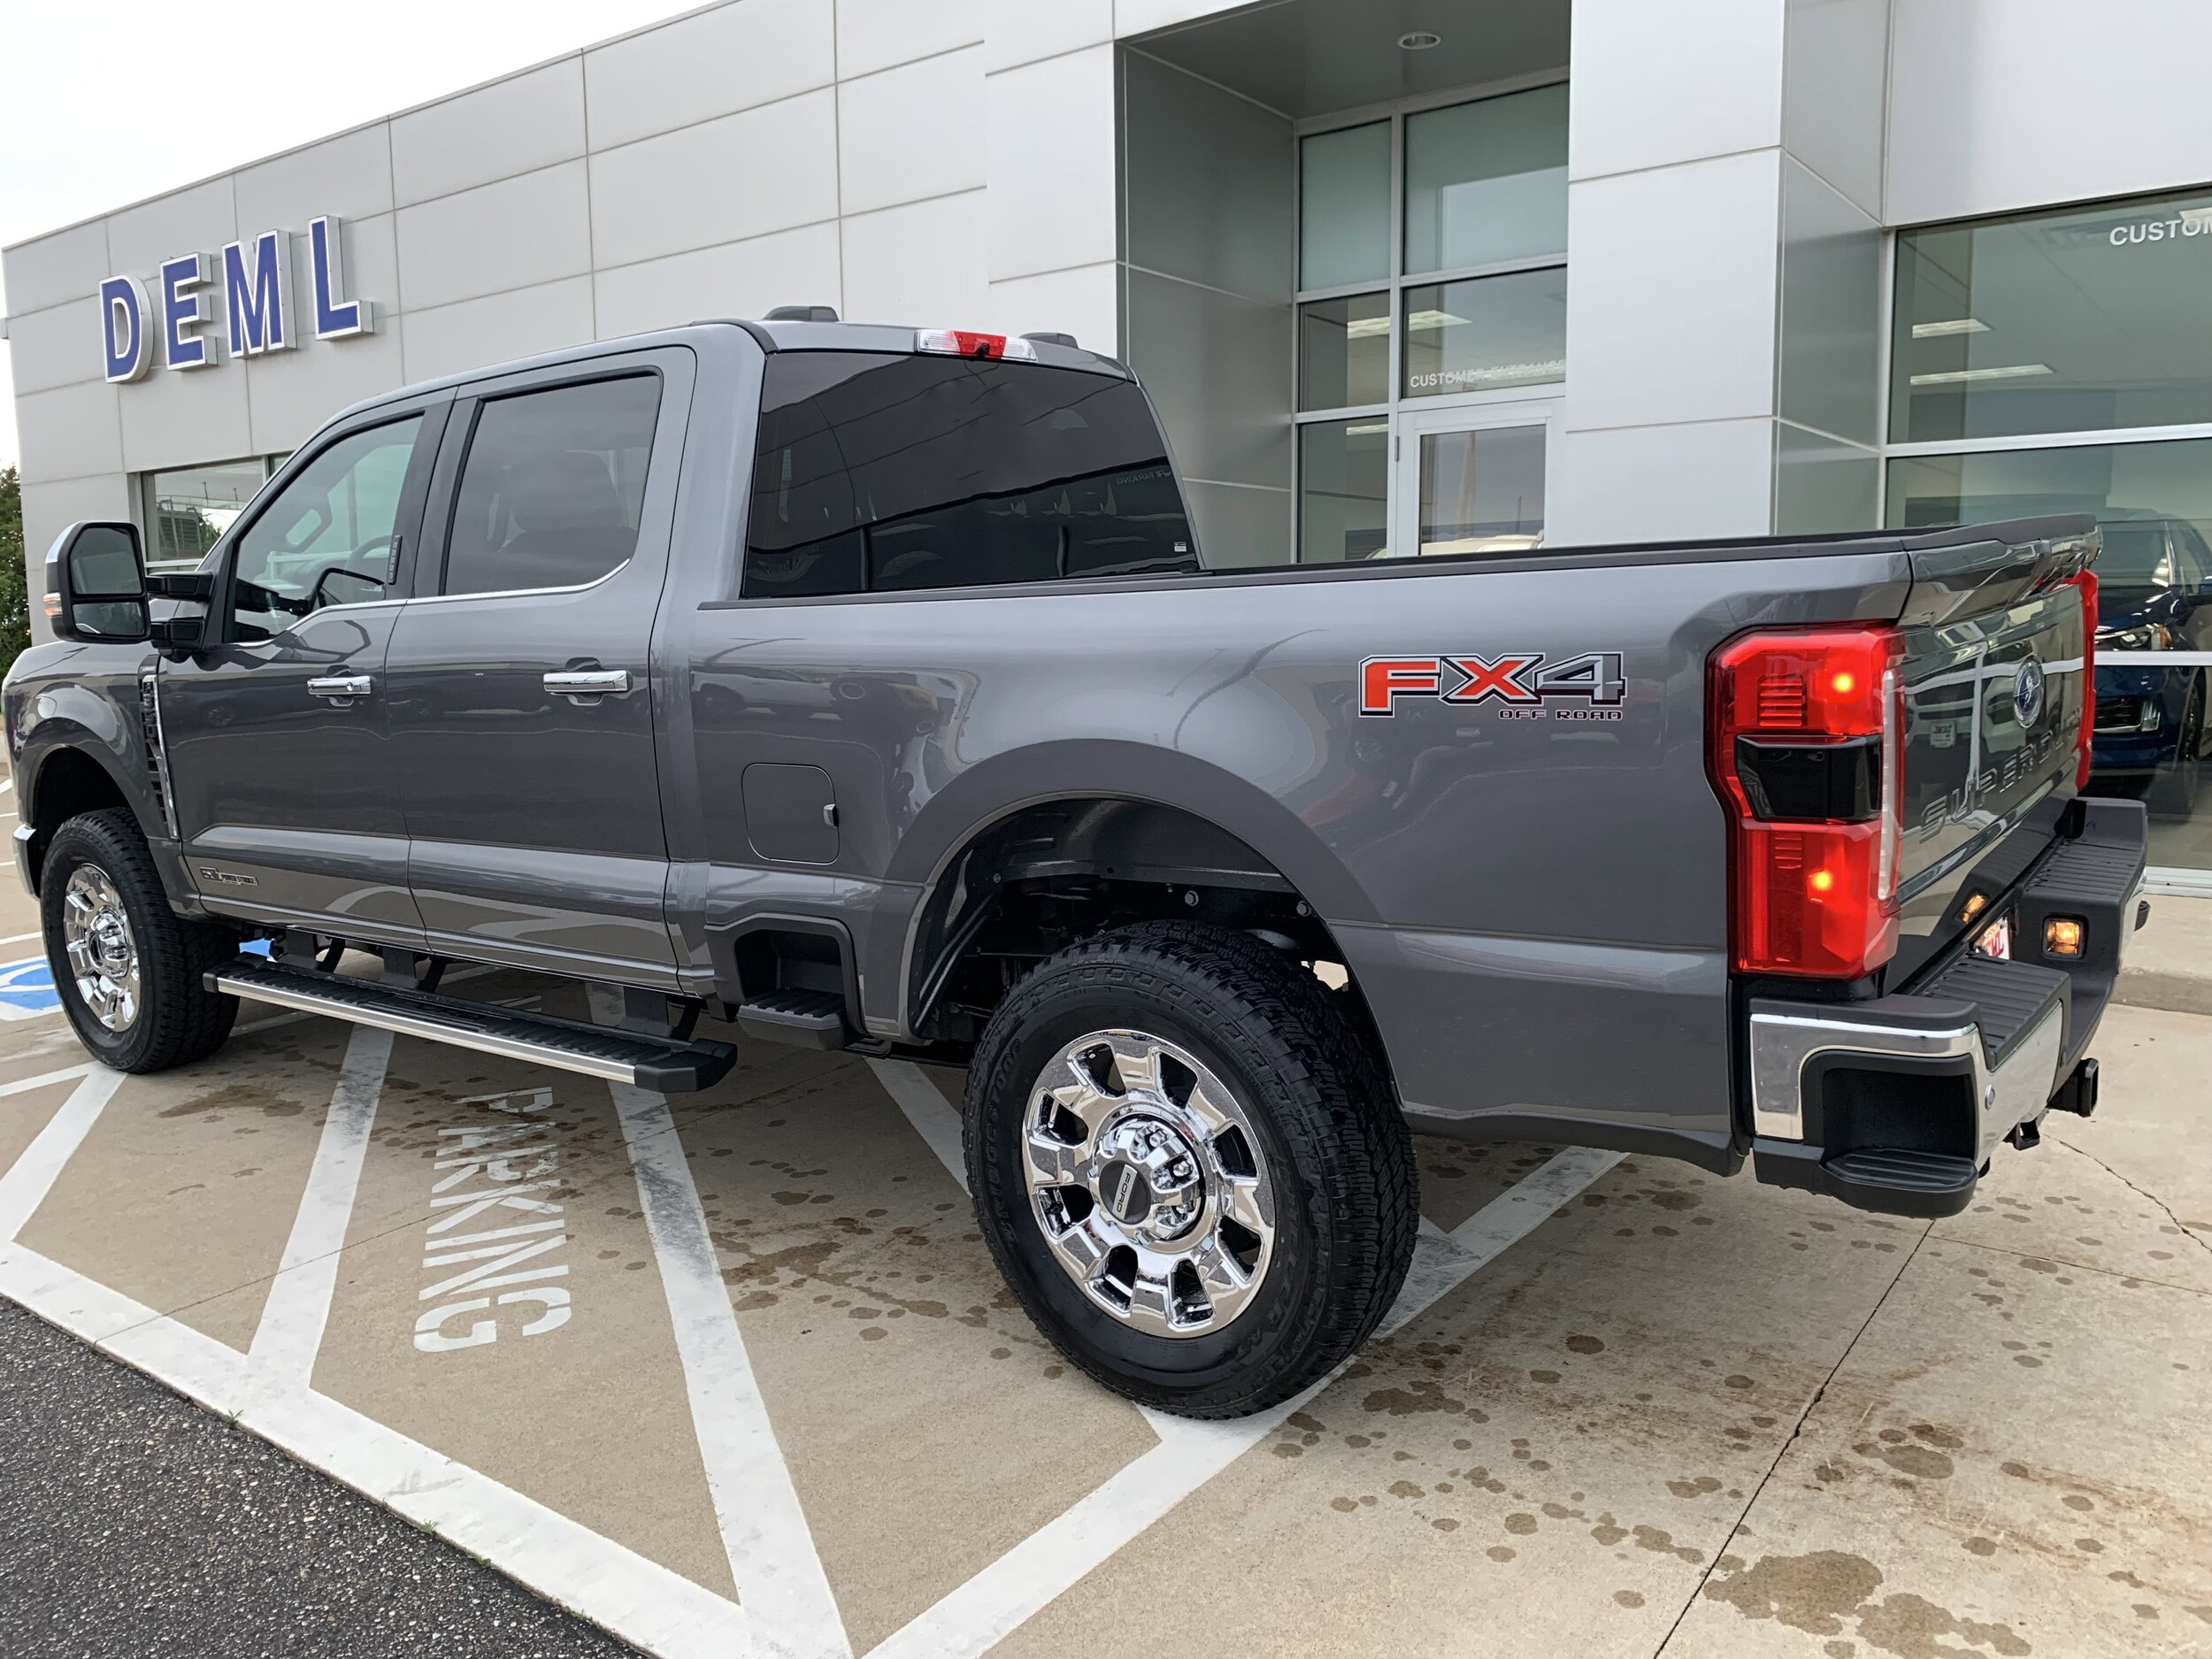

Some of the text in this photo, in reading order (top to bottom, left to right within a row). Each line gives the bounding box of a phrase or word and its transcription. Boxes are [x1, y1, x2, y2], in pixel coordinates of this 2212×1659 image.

[99, 215, 373, 384] DEML
[1409, 367, 1486, 388] CUSTOMER
[1358, 651, 1628, 718] FX4
[1498, 709, 1623, 720] OFF ROAD
[412, 1086, 572, 1353] PARKING
[1116, 1172, 1132, 1213] FORD
